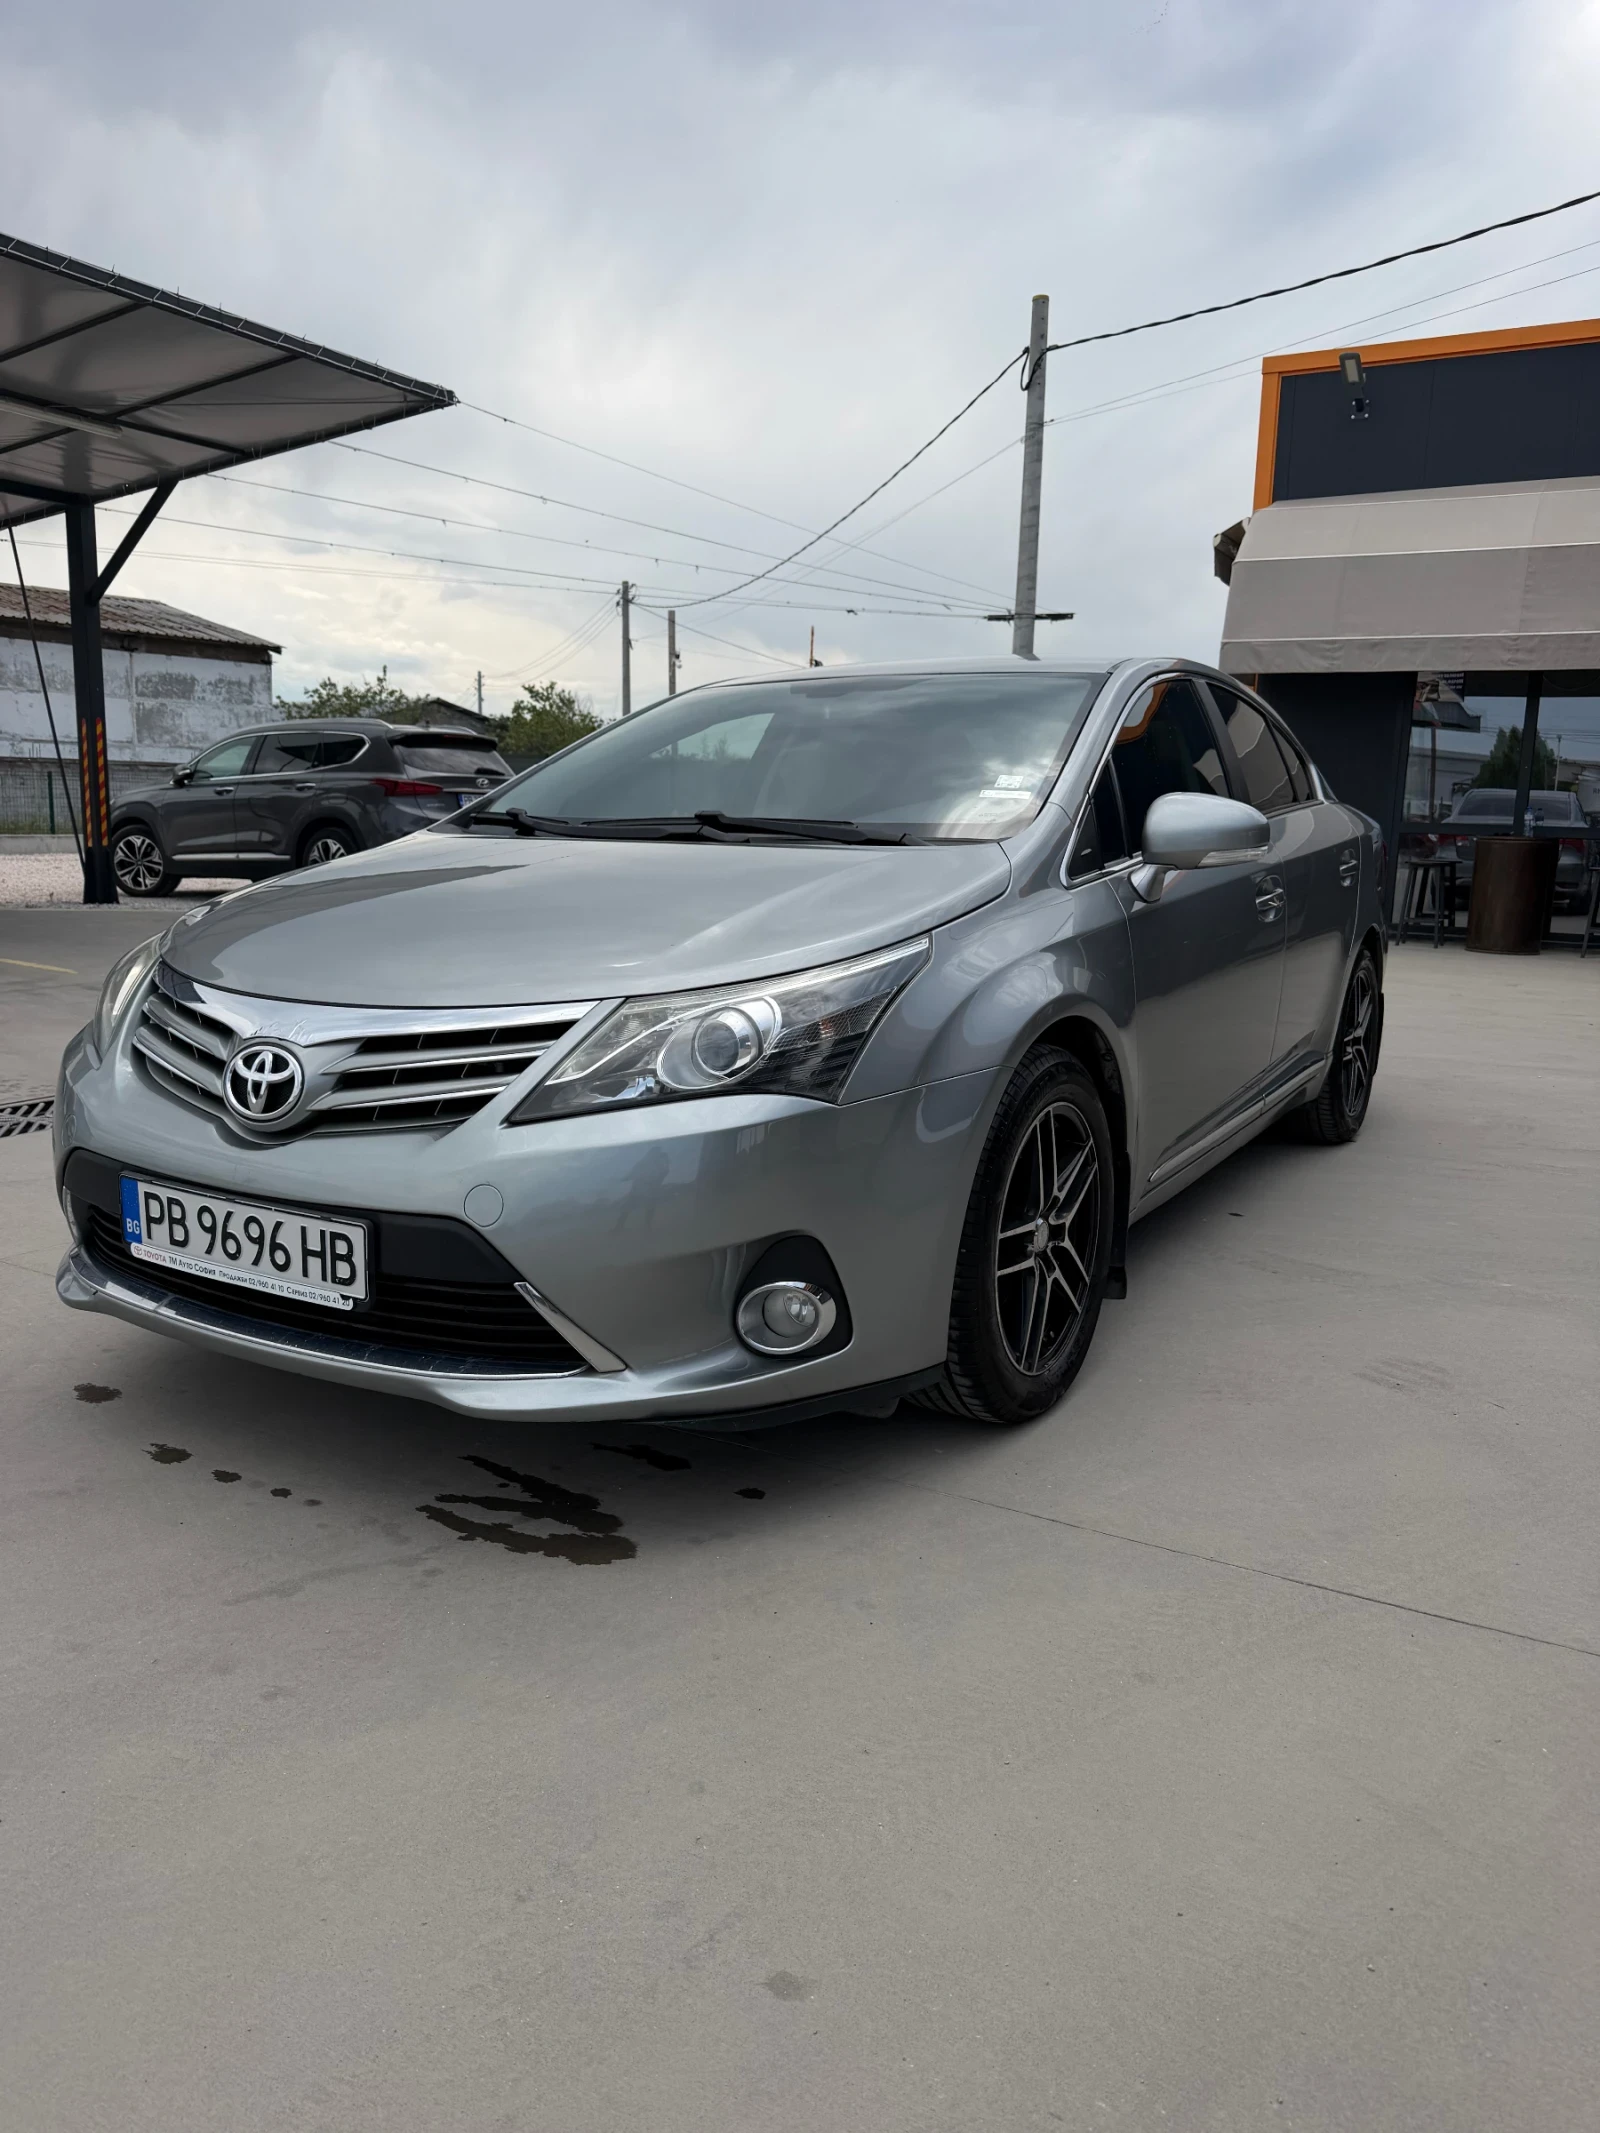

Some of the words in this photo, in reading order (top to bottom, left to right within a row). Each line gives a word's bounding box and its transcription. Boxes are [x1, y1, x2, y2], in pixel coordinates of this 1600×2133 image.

[126, 1219, 141, 1235] BG
[143, 1190, 190, 1248] PB
[196, 1203, 292, 1273] 9696
[300, 1224, 357, 1287] HB
[143, 1249, 167, 1263] TOYOTA
[308, 1291, 331, 1304] 02/960
[332, 1297, 340, 1305] 41
